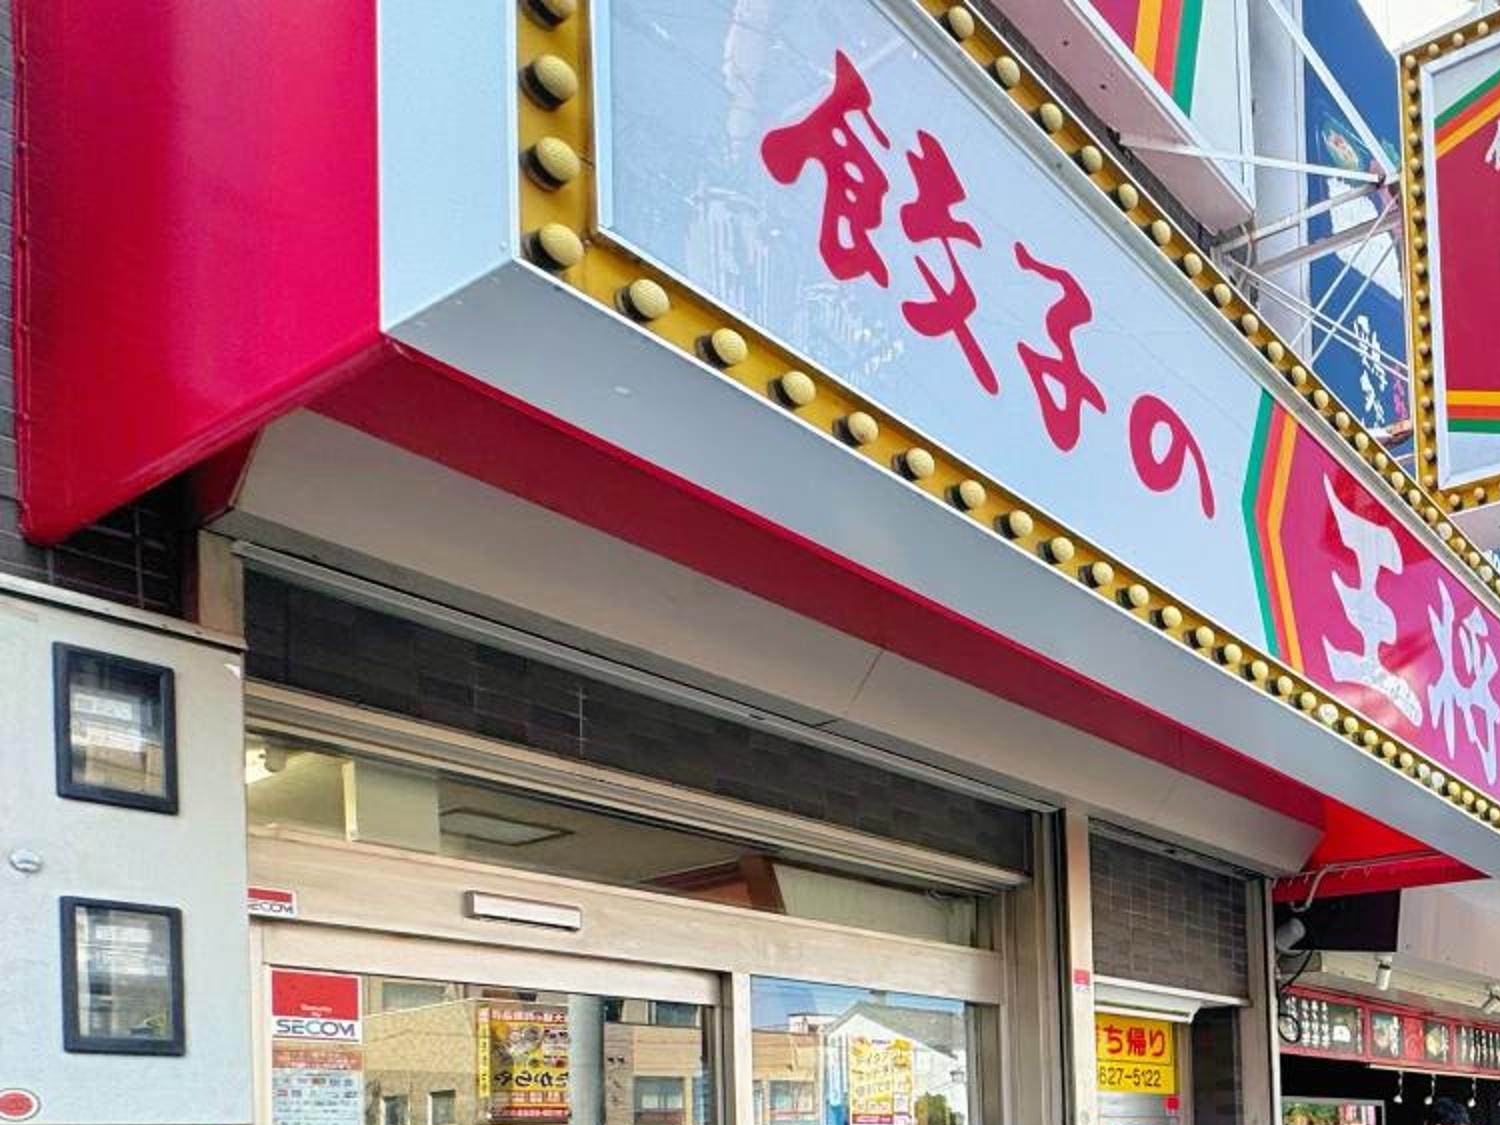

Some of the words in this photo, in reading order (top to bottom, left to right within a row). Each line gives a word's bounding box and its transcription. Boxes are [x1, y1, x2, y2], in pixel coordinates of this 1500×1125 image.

[247, 901, 294, 914] ECOM
[275, 1018, 356, 1037] SECOM
[1096, 1023, 1167, 1058] ち帰り
